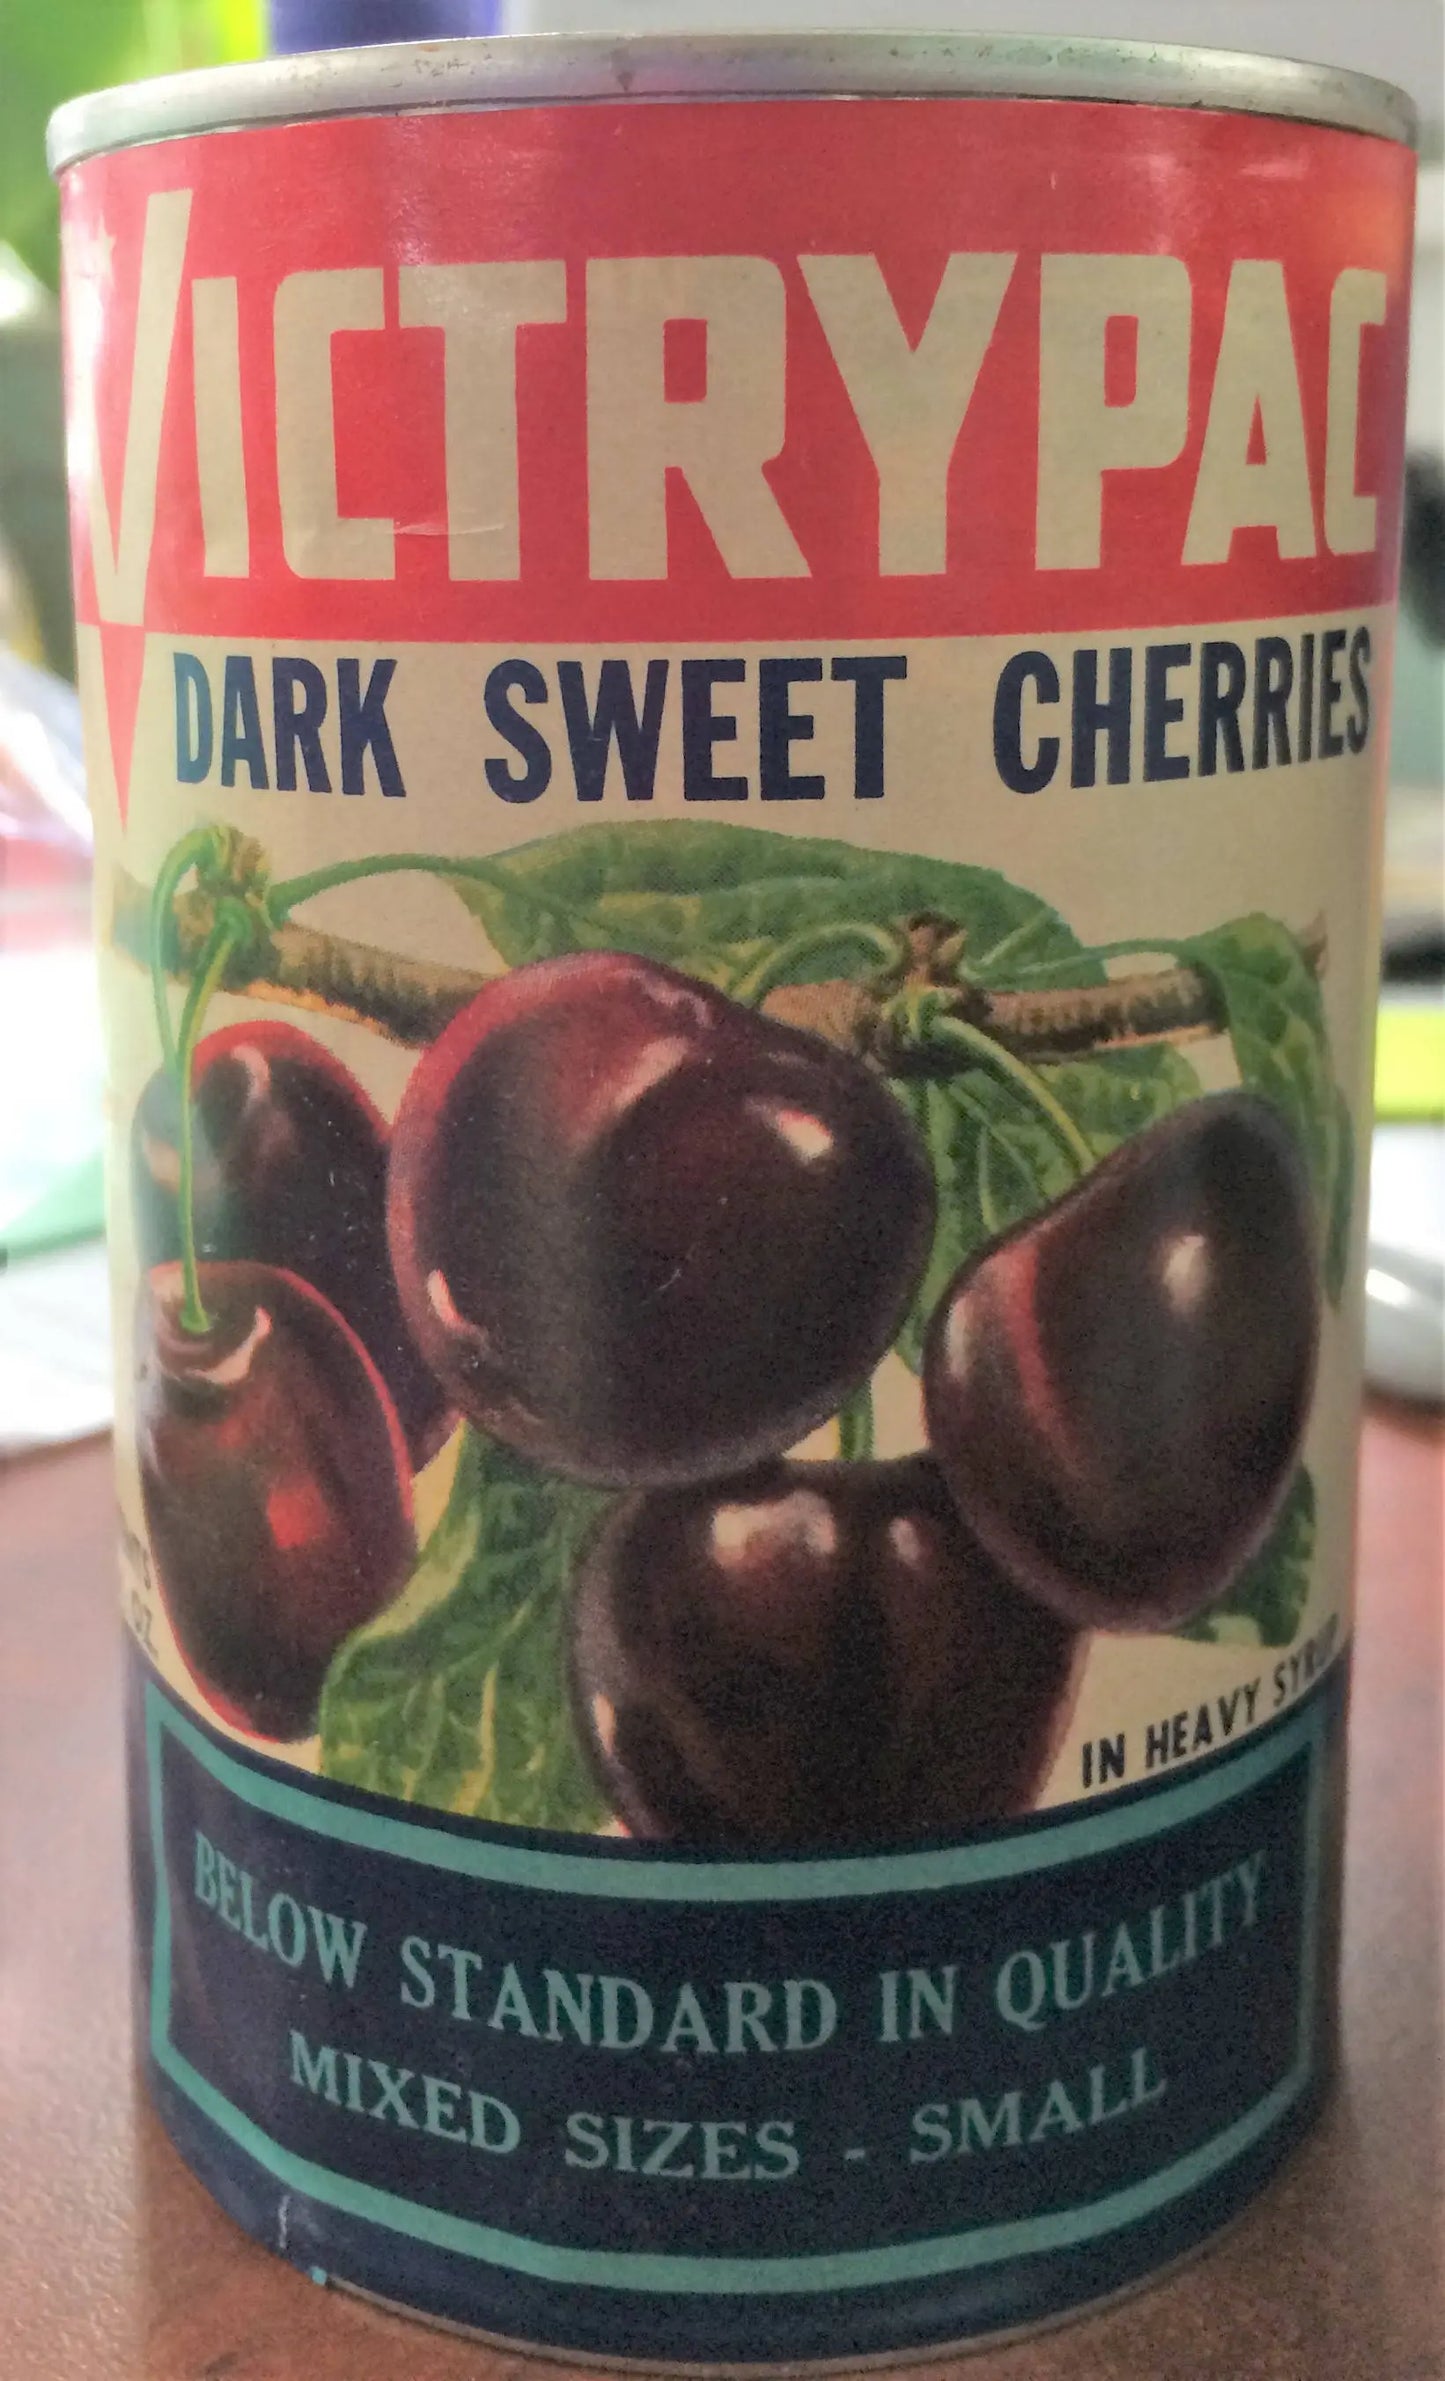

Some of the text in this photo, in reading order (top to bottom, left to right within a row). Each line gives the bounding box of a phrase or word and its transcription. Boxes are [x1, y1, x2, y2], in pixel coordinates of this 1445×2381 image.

[62, 187, 1388, 628] VICTRYPAC
[173, 626, 1373, 803] DARK SWEET CHERRIES
[1082, 1733, 1126, 1788] IN
[1145, 1677, 1262, 1768] HEAVY
[195, 1830, 1267, 2053] BELOW STANDARD IN QUALITY
[289, 2030, 521, 2155] MIXED
[564, 2112, 801, 2180] SIZES
[909, 2046, 1168, 2164] SMALL
